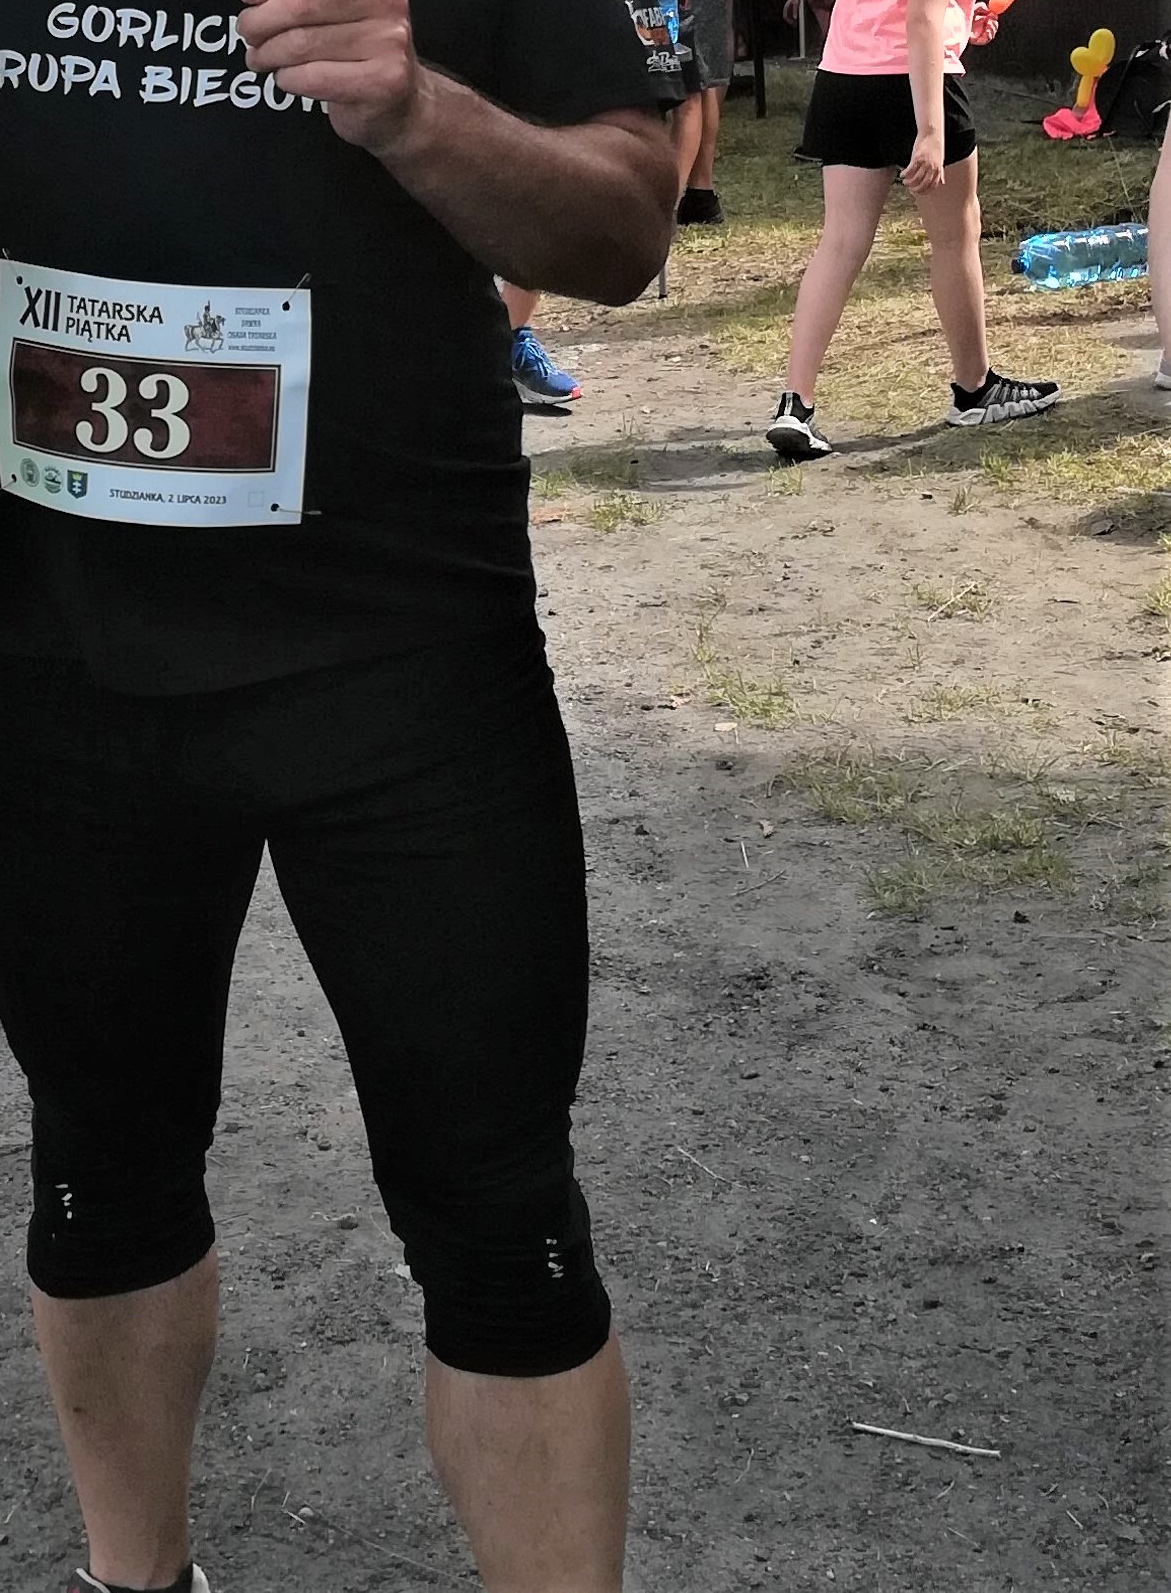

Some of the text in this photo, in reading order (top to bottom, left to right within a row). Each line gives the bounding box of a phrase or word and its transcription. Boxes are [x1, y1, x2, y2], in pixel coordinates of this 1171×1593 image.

[47, 2, 247, 56] GORLICK
[139, 65, 330, 115] BIEGO
[19, 286, 163, 332] XII TATARSKA
[65, 316, 132, 343] PIĄTKA
[75, 366, 191, 459] 33
[109, 489, 227, 504] STUDZIANKA, 2 LIPCA 2023
